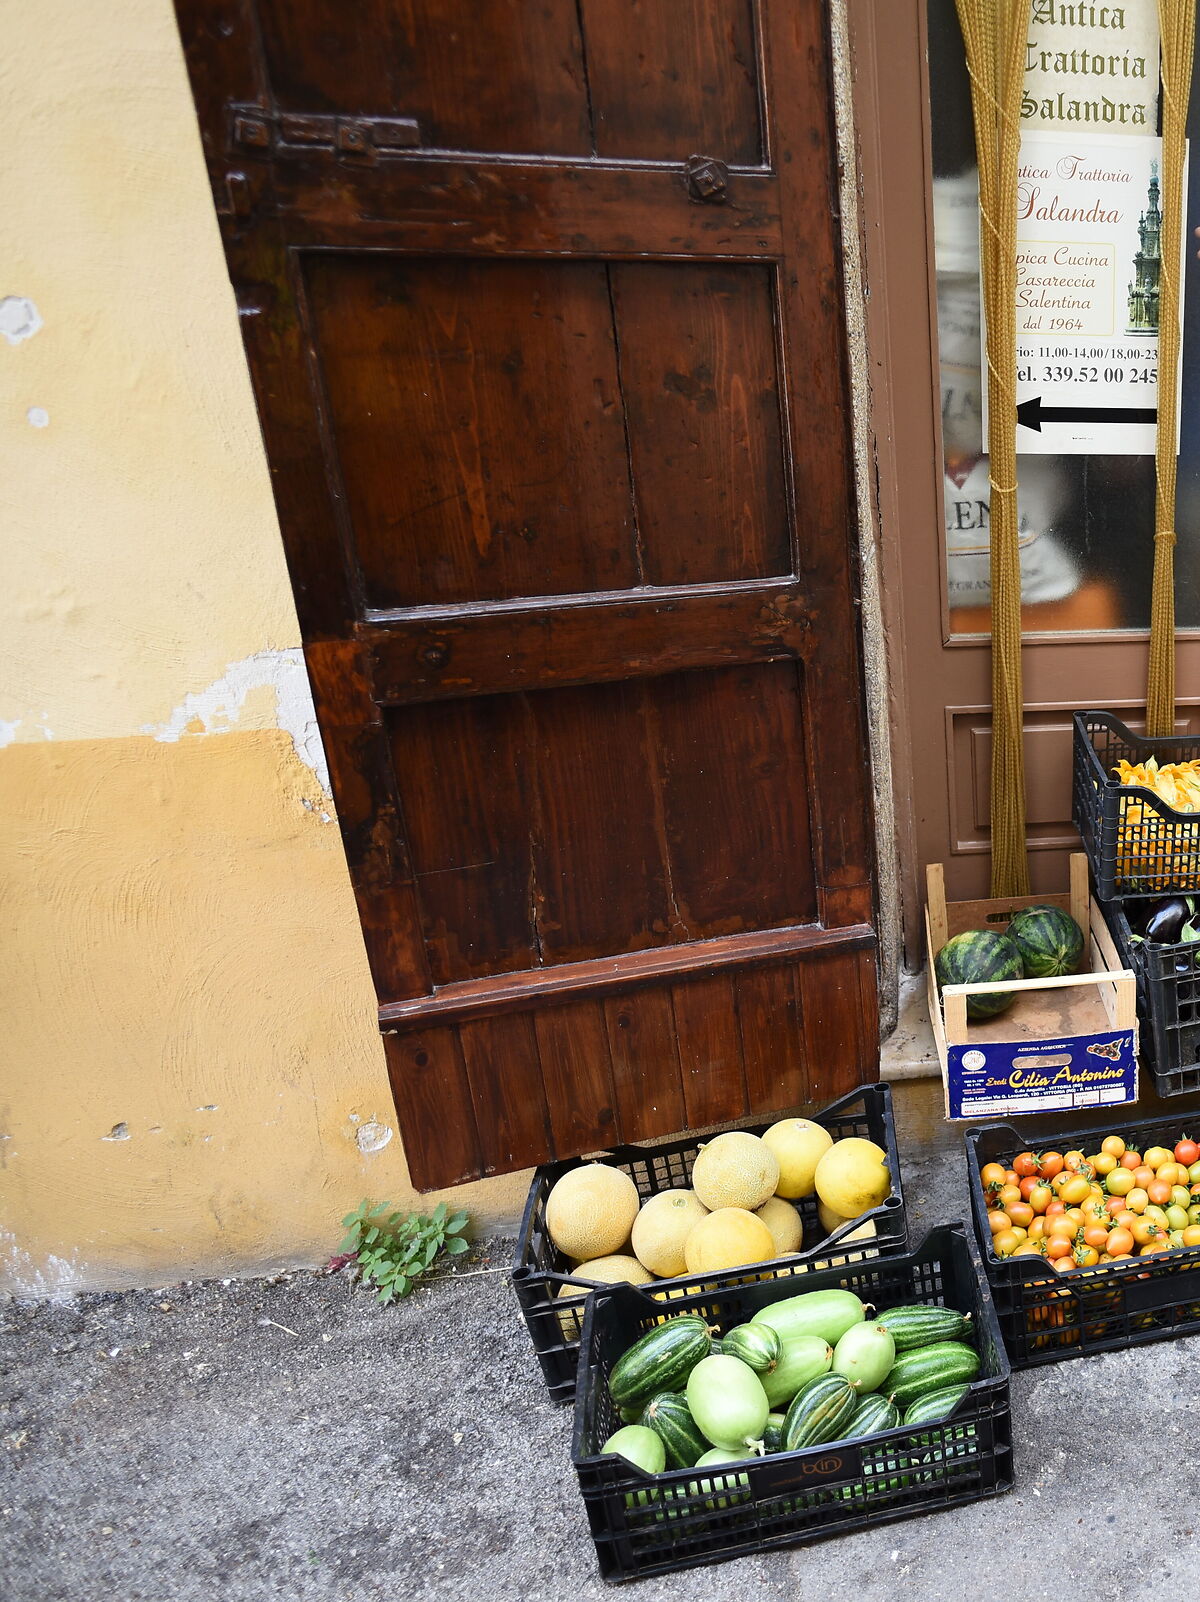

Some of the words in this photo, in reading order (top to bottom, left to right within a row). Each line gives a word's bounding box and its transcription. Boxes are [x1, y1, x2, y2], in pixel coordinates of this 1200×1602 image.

[1032, 0, 1126, 30] Antica
[1020, 90, 1146, 125] Salandra
[1017, 165, 1051, 179] ntica
[1055, 155, 1133, 183] Trattoria
[1017, 182, 1124, 224] Salandra
[1016, 249, 1047, 265] pica
[1053, 246, 1109, 267] Cucina
[1016, 289, 1092, 309] Salentina
[1022, 315, 1042, 330] dal
[1048, 318, 1084, 331] 1964
[1016, 366, 1037, 382] el.
[1042, 366, 1098, 383] 339.52
[1104, 367, 1124, 384] 00
[1129, 368, 1158, 384] 245
[1009, 1069, 1050, 1088] Cilia
[1052, 1066, 1125, 1084] Antonino
